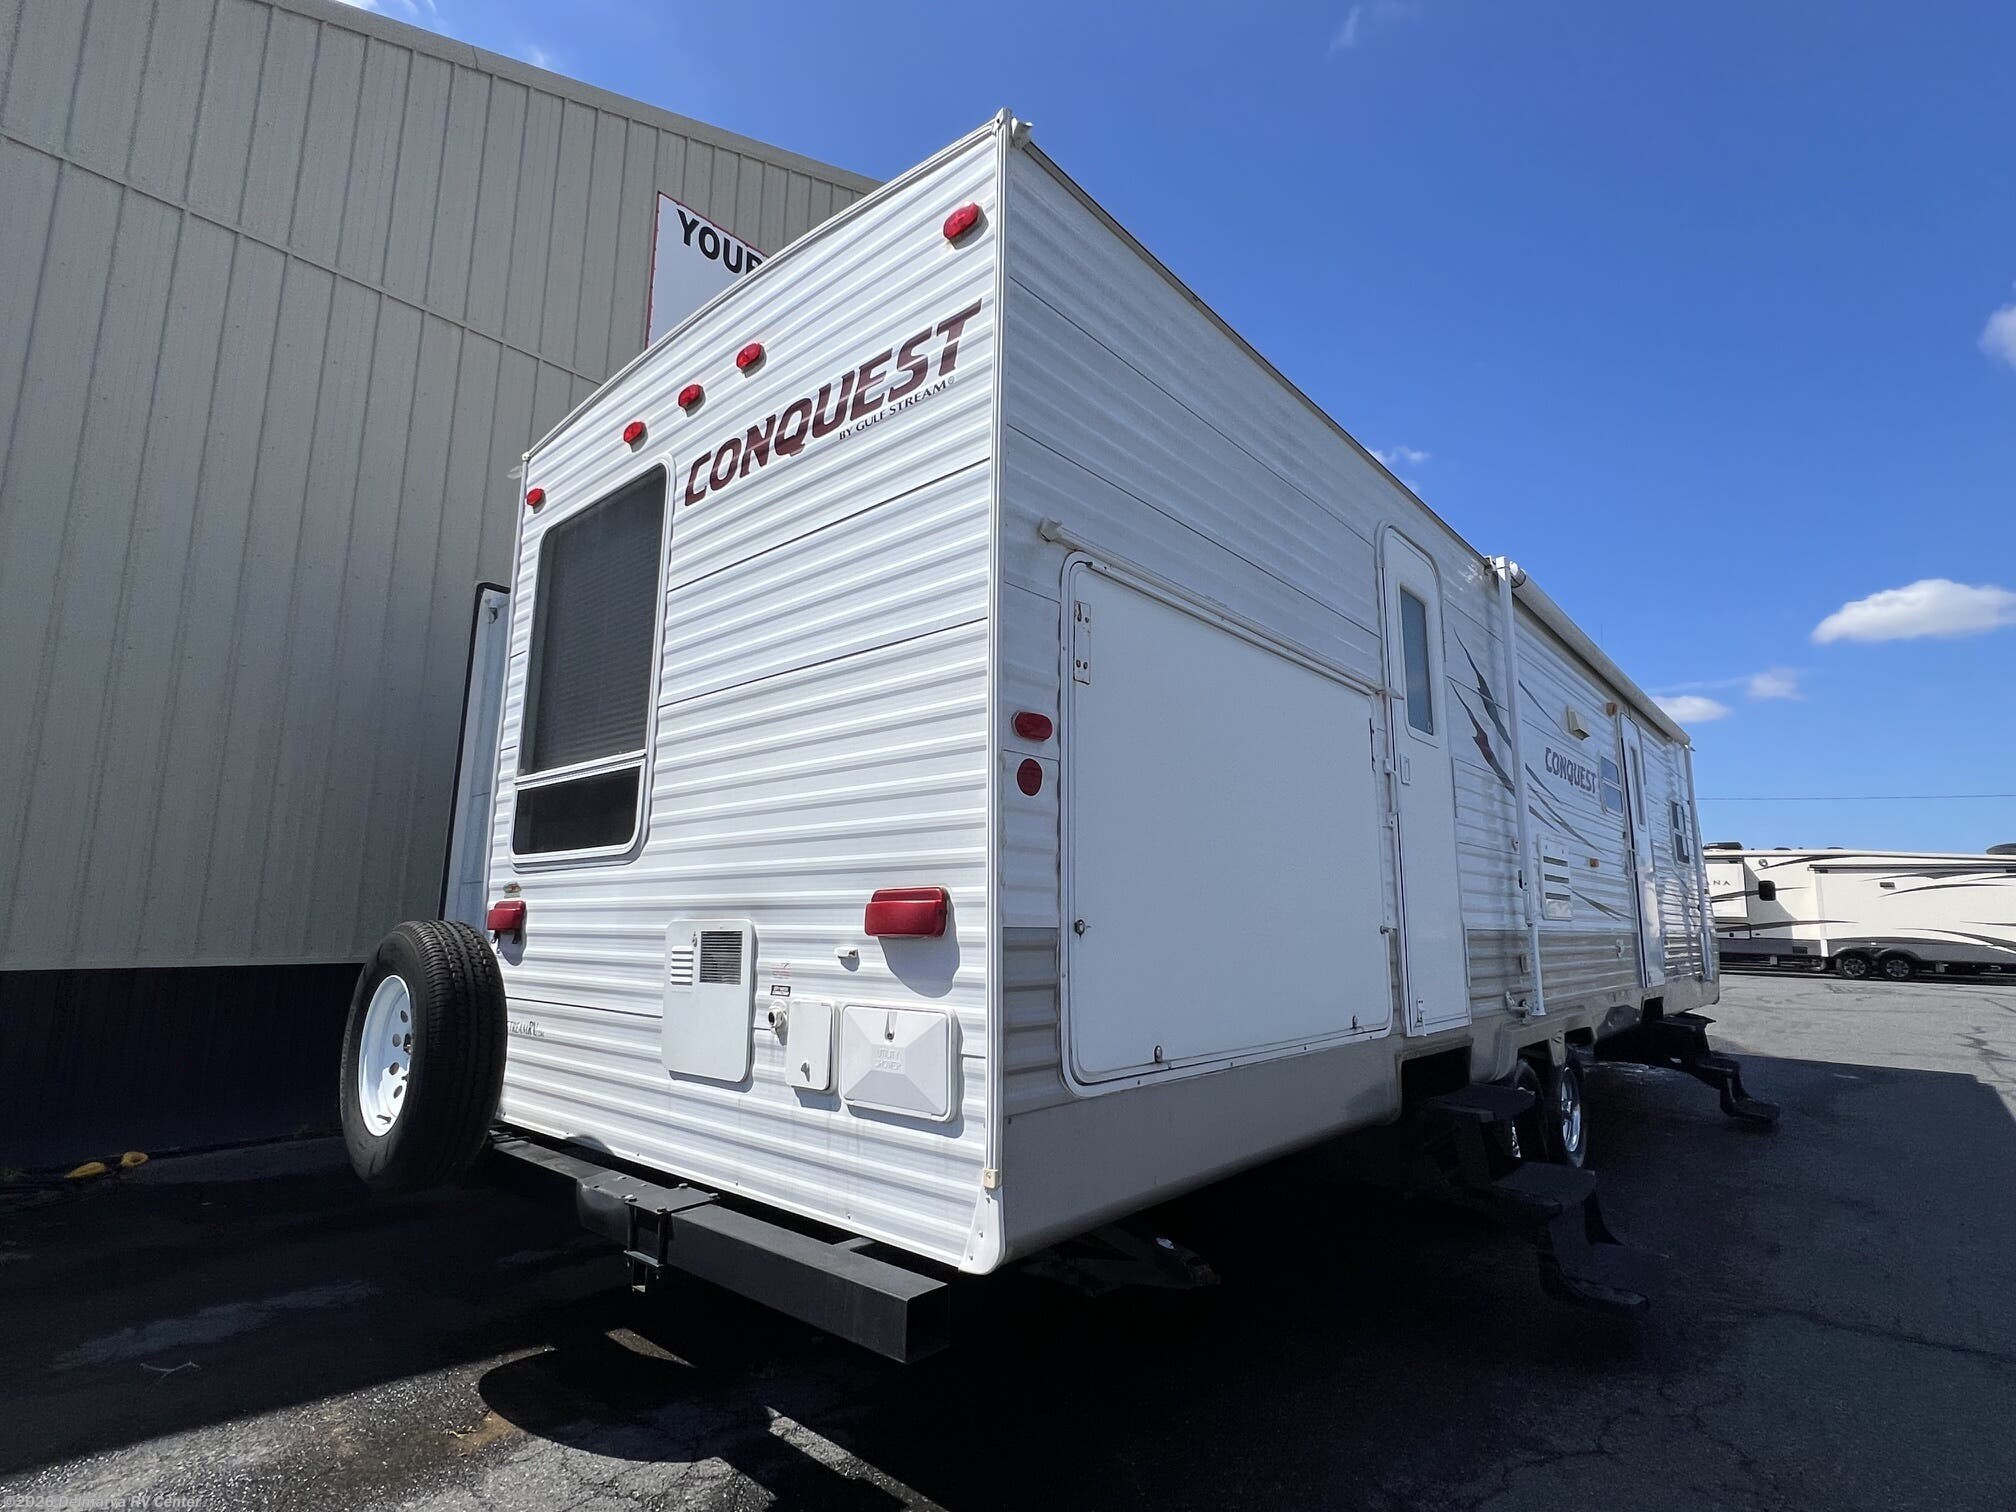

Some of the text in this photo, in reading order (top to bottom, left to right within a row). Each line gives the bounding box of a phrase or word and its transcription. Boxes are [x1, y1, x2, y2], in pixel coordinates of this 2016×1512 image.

[684, 298, 983, 506] CONQUEST
[839, 426, 853, 440] BY
[856, 411, 887, 432] GULF
[1545, 747, 1596, 793] CONQUEST
